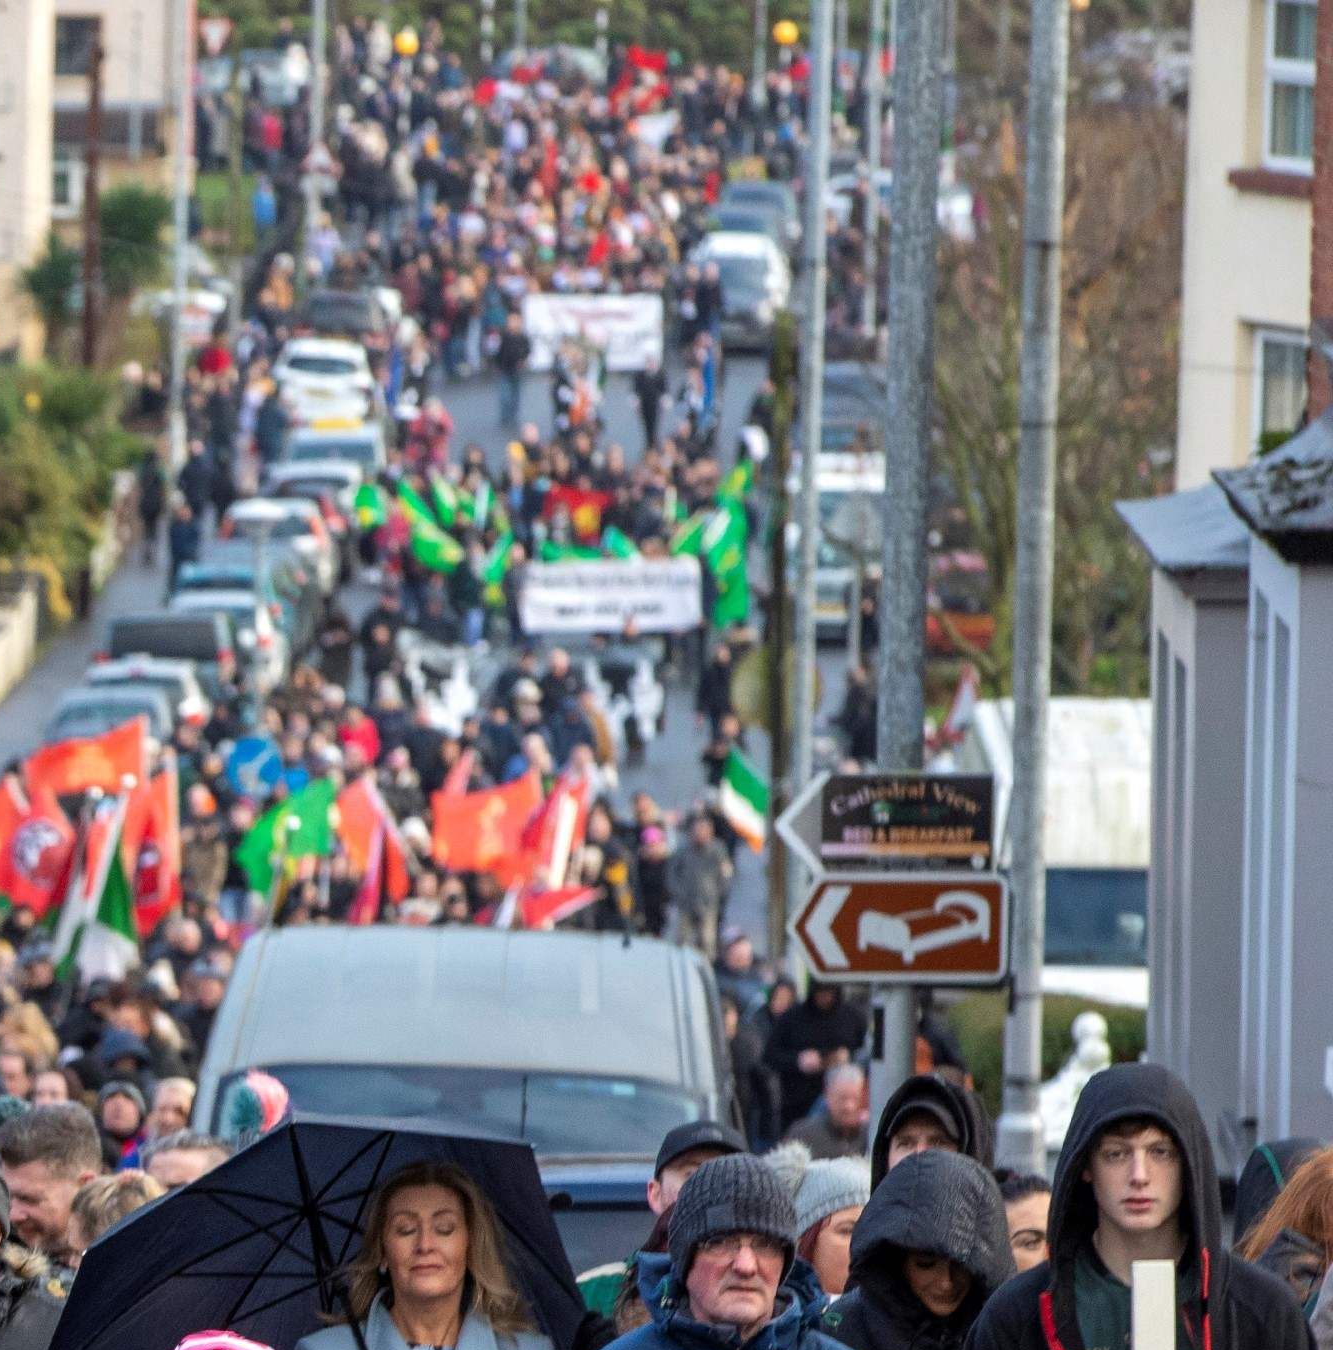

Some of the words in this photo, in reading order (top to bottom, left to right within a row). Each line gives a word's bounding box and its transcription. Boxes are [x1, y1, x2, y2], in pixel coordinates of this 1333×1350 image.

[831, 782, 925, 816] Cathedral
[933, 783, 981, 815] View
[889, 825, 974, 842] BREAKFAST
